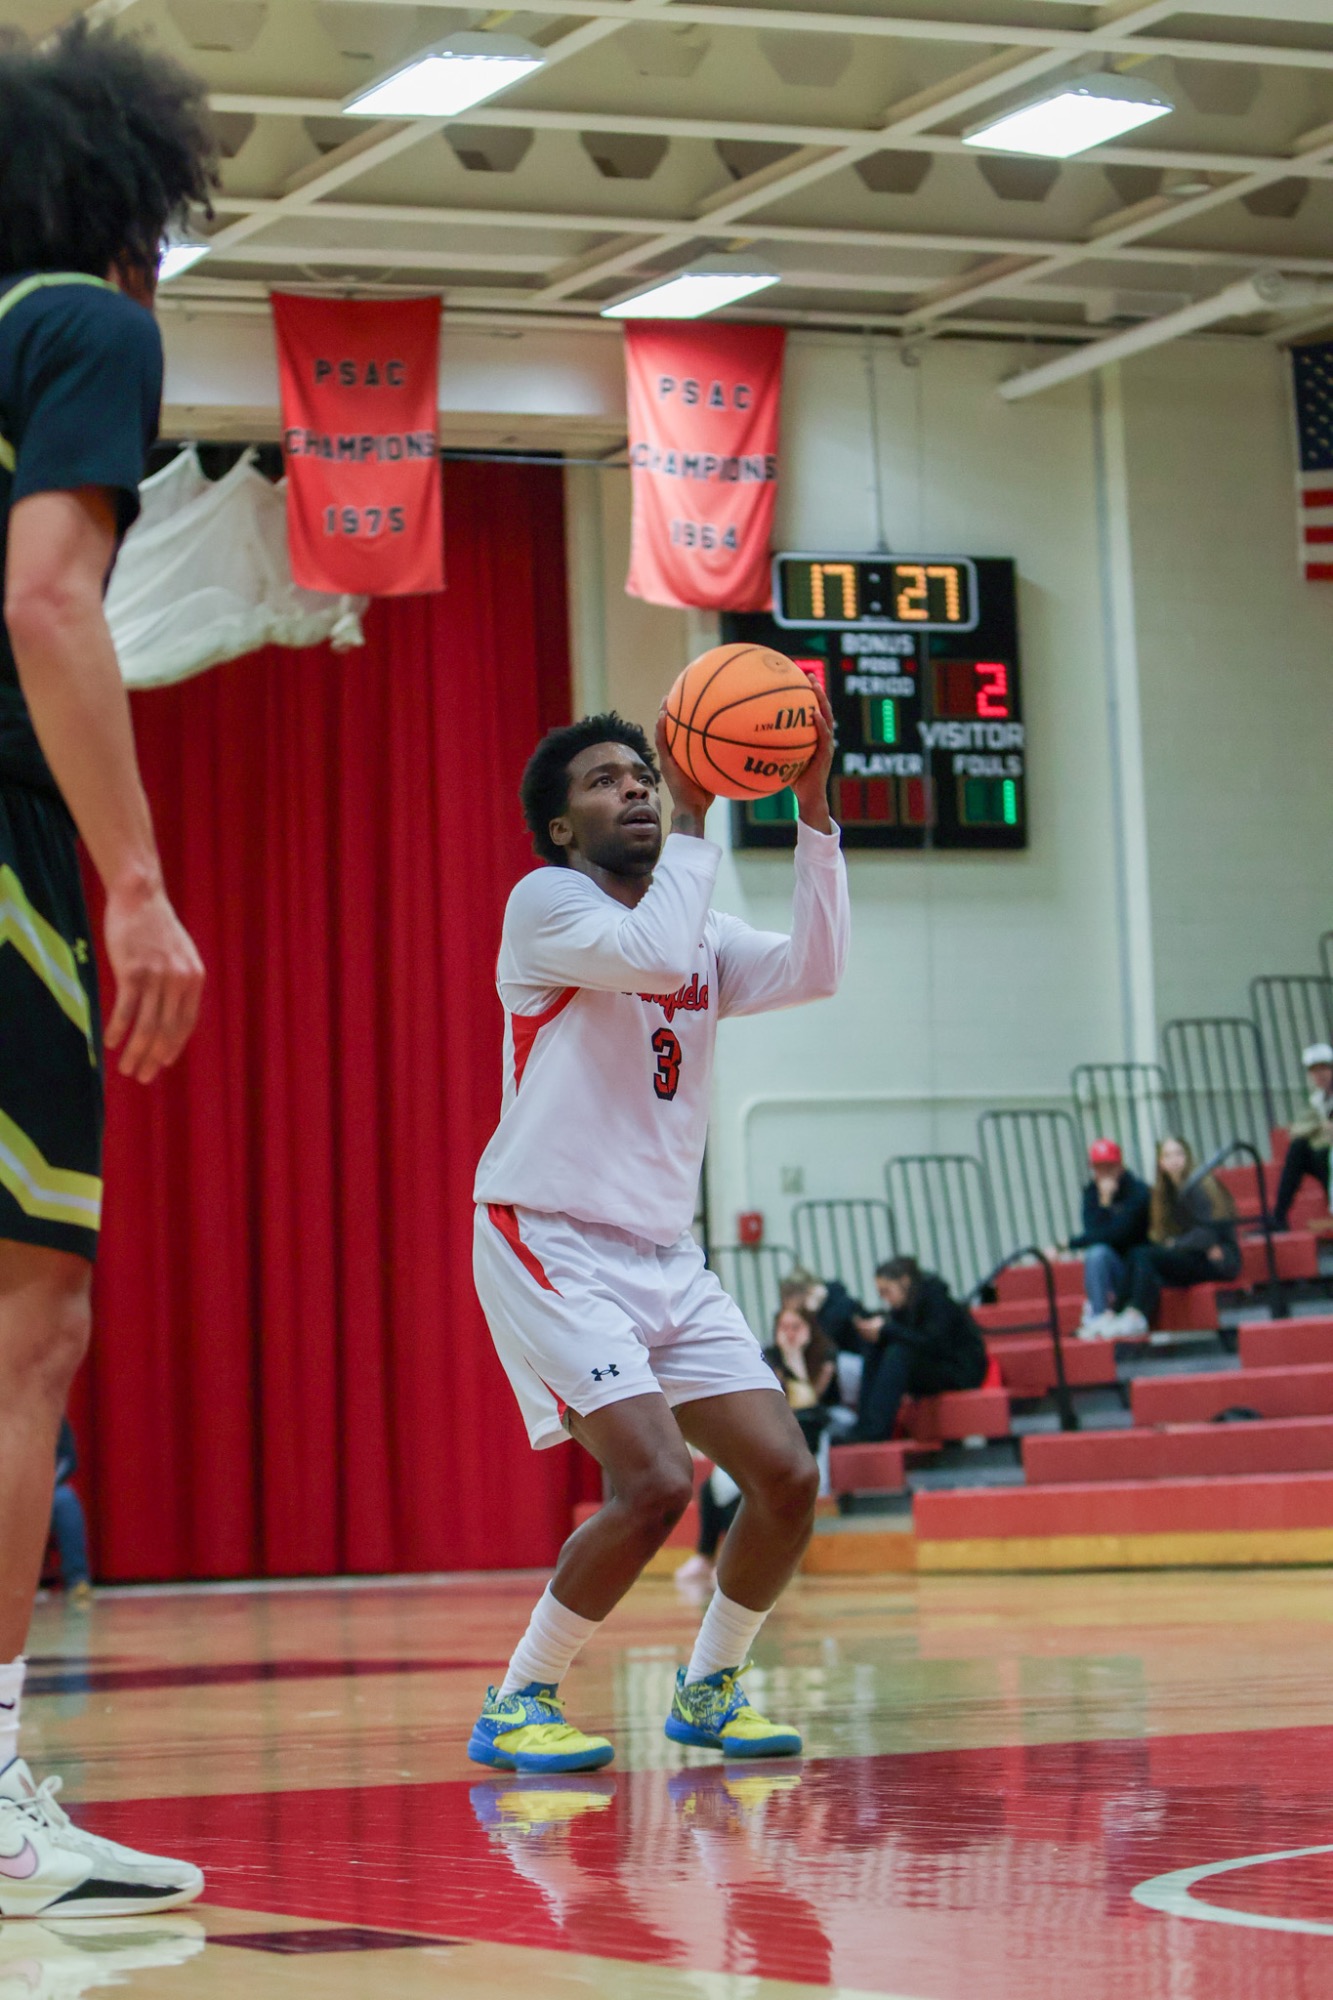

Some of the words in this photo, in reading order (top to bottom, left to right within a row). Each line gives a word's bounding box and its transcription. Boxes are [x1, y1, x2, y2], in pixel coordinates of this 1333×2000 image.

[314, 359, 405, 386] PSAC
[659, 377, 751, 410] PSAC
[285, 428, 435, 462] CHAMPIONS
[632, 442, 777, 482] CHAMPIONS
[324, 505, 405, 536] 1975
[840, 633, 915, 656] BONUS
[845, 675, 915, 697] PERIOD
[974, 662, 1009, 718] 2
[882, 699, 896, 744] 1
[917, 721, 1025, 749] VISITOR
[843, 753, 924, 776] PLAYER
[953, 753, 1022, 777] FOULS
[1002, 779, 1017, 825] 1
[651, 1027, 682, 1101] 3
